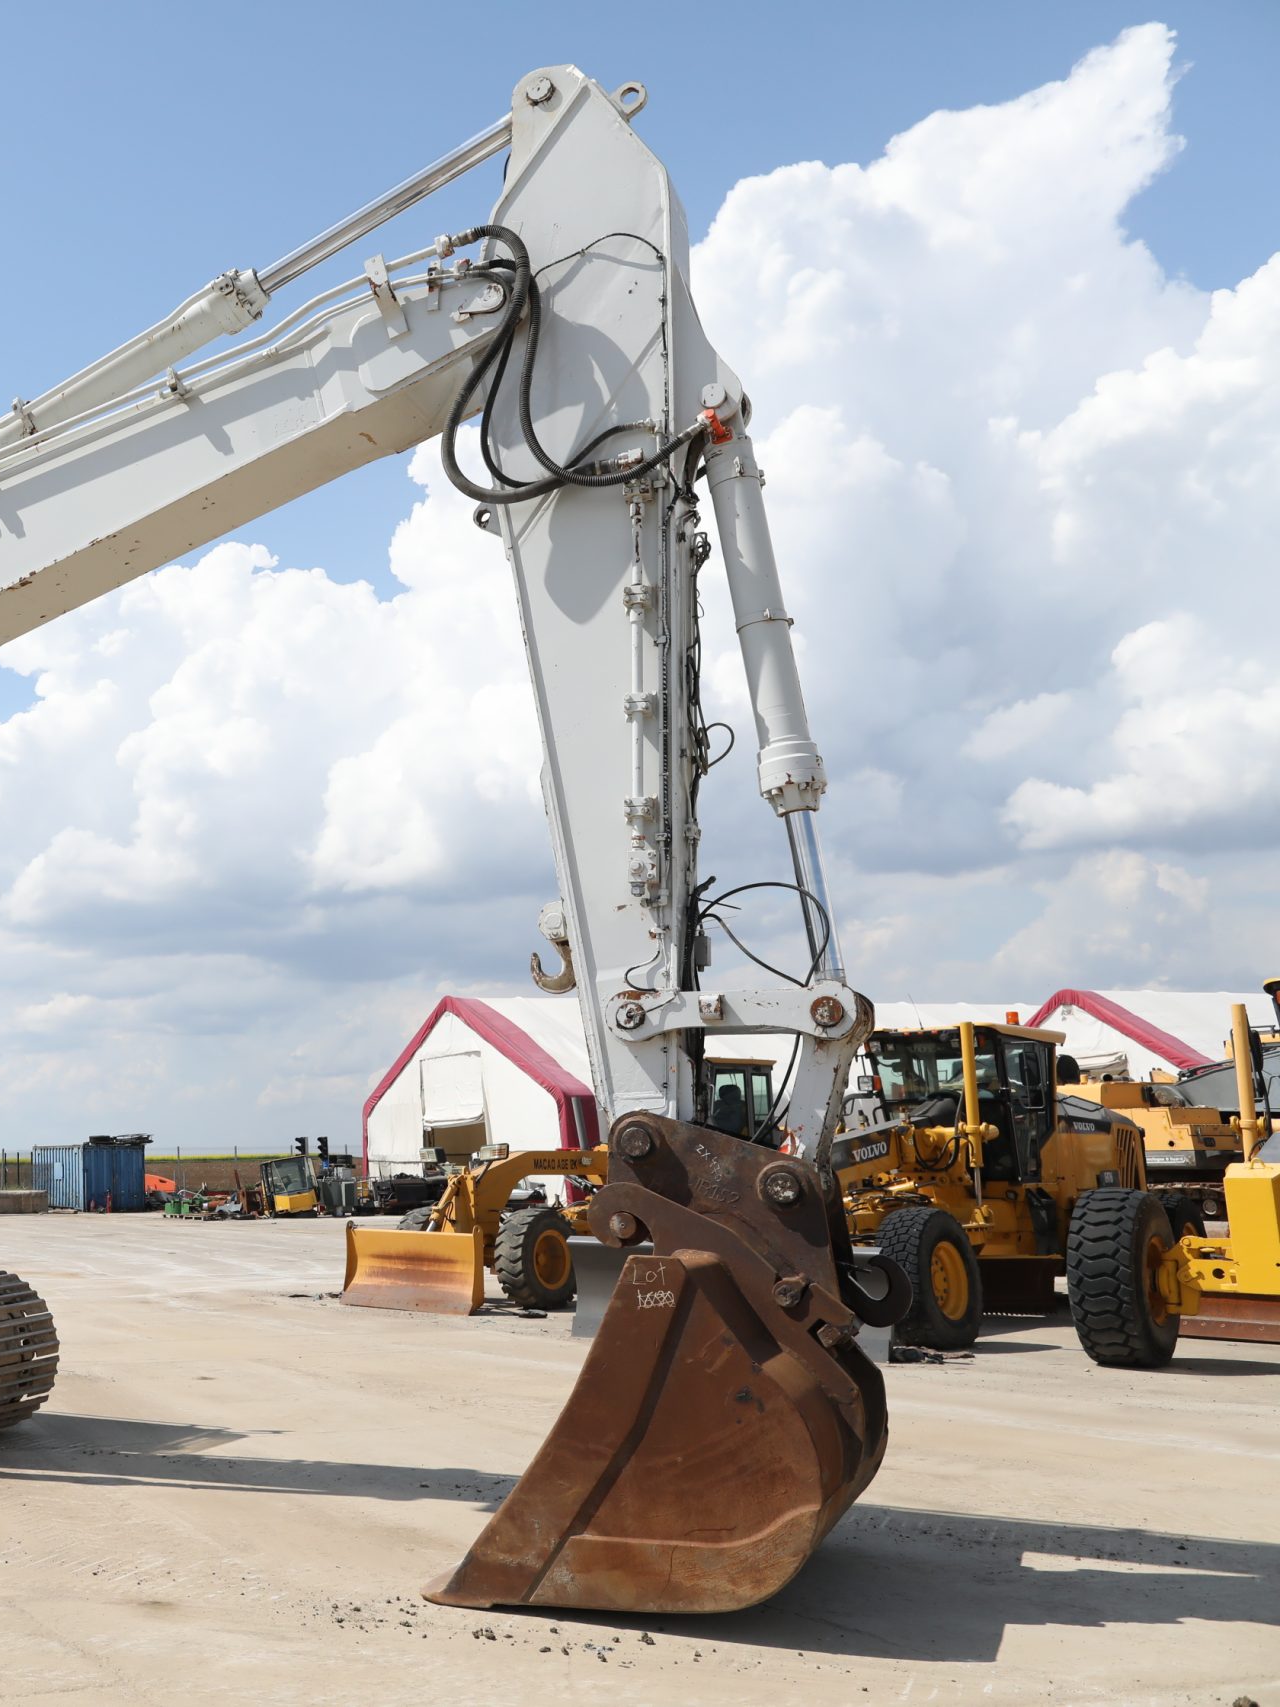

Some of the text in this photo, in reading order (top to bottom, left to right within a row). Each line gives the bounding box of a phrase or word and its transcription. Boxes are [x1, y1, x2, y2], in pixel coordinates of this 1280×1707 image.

[1072, 1121, 1096, 1132] VOLVO
[852, 1141, 888, 1162] VOLVO
[632, 1261, 667, 1286] Lot
